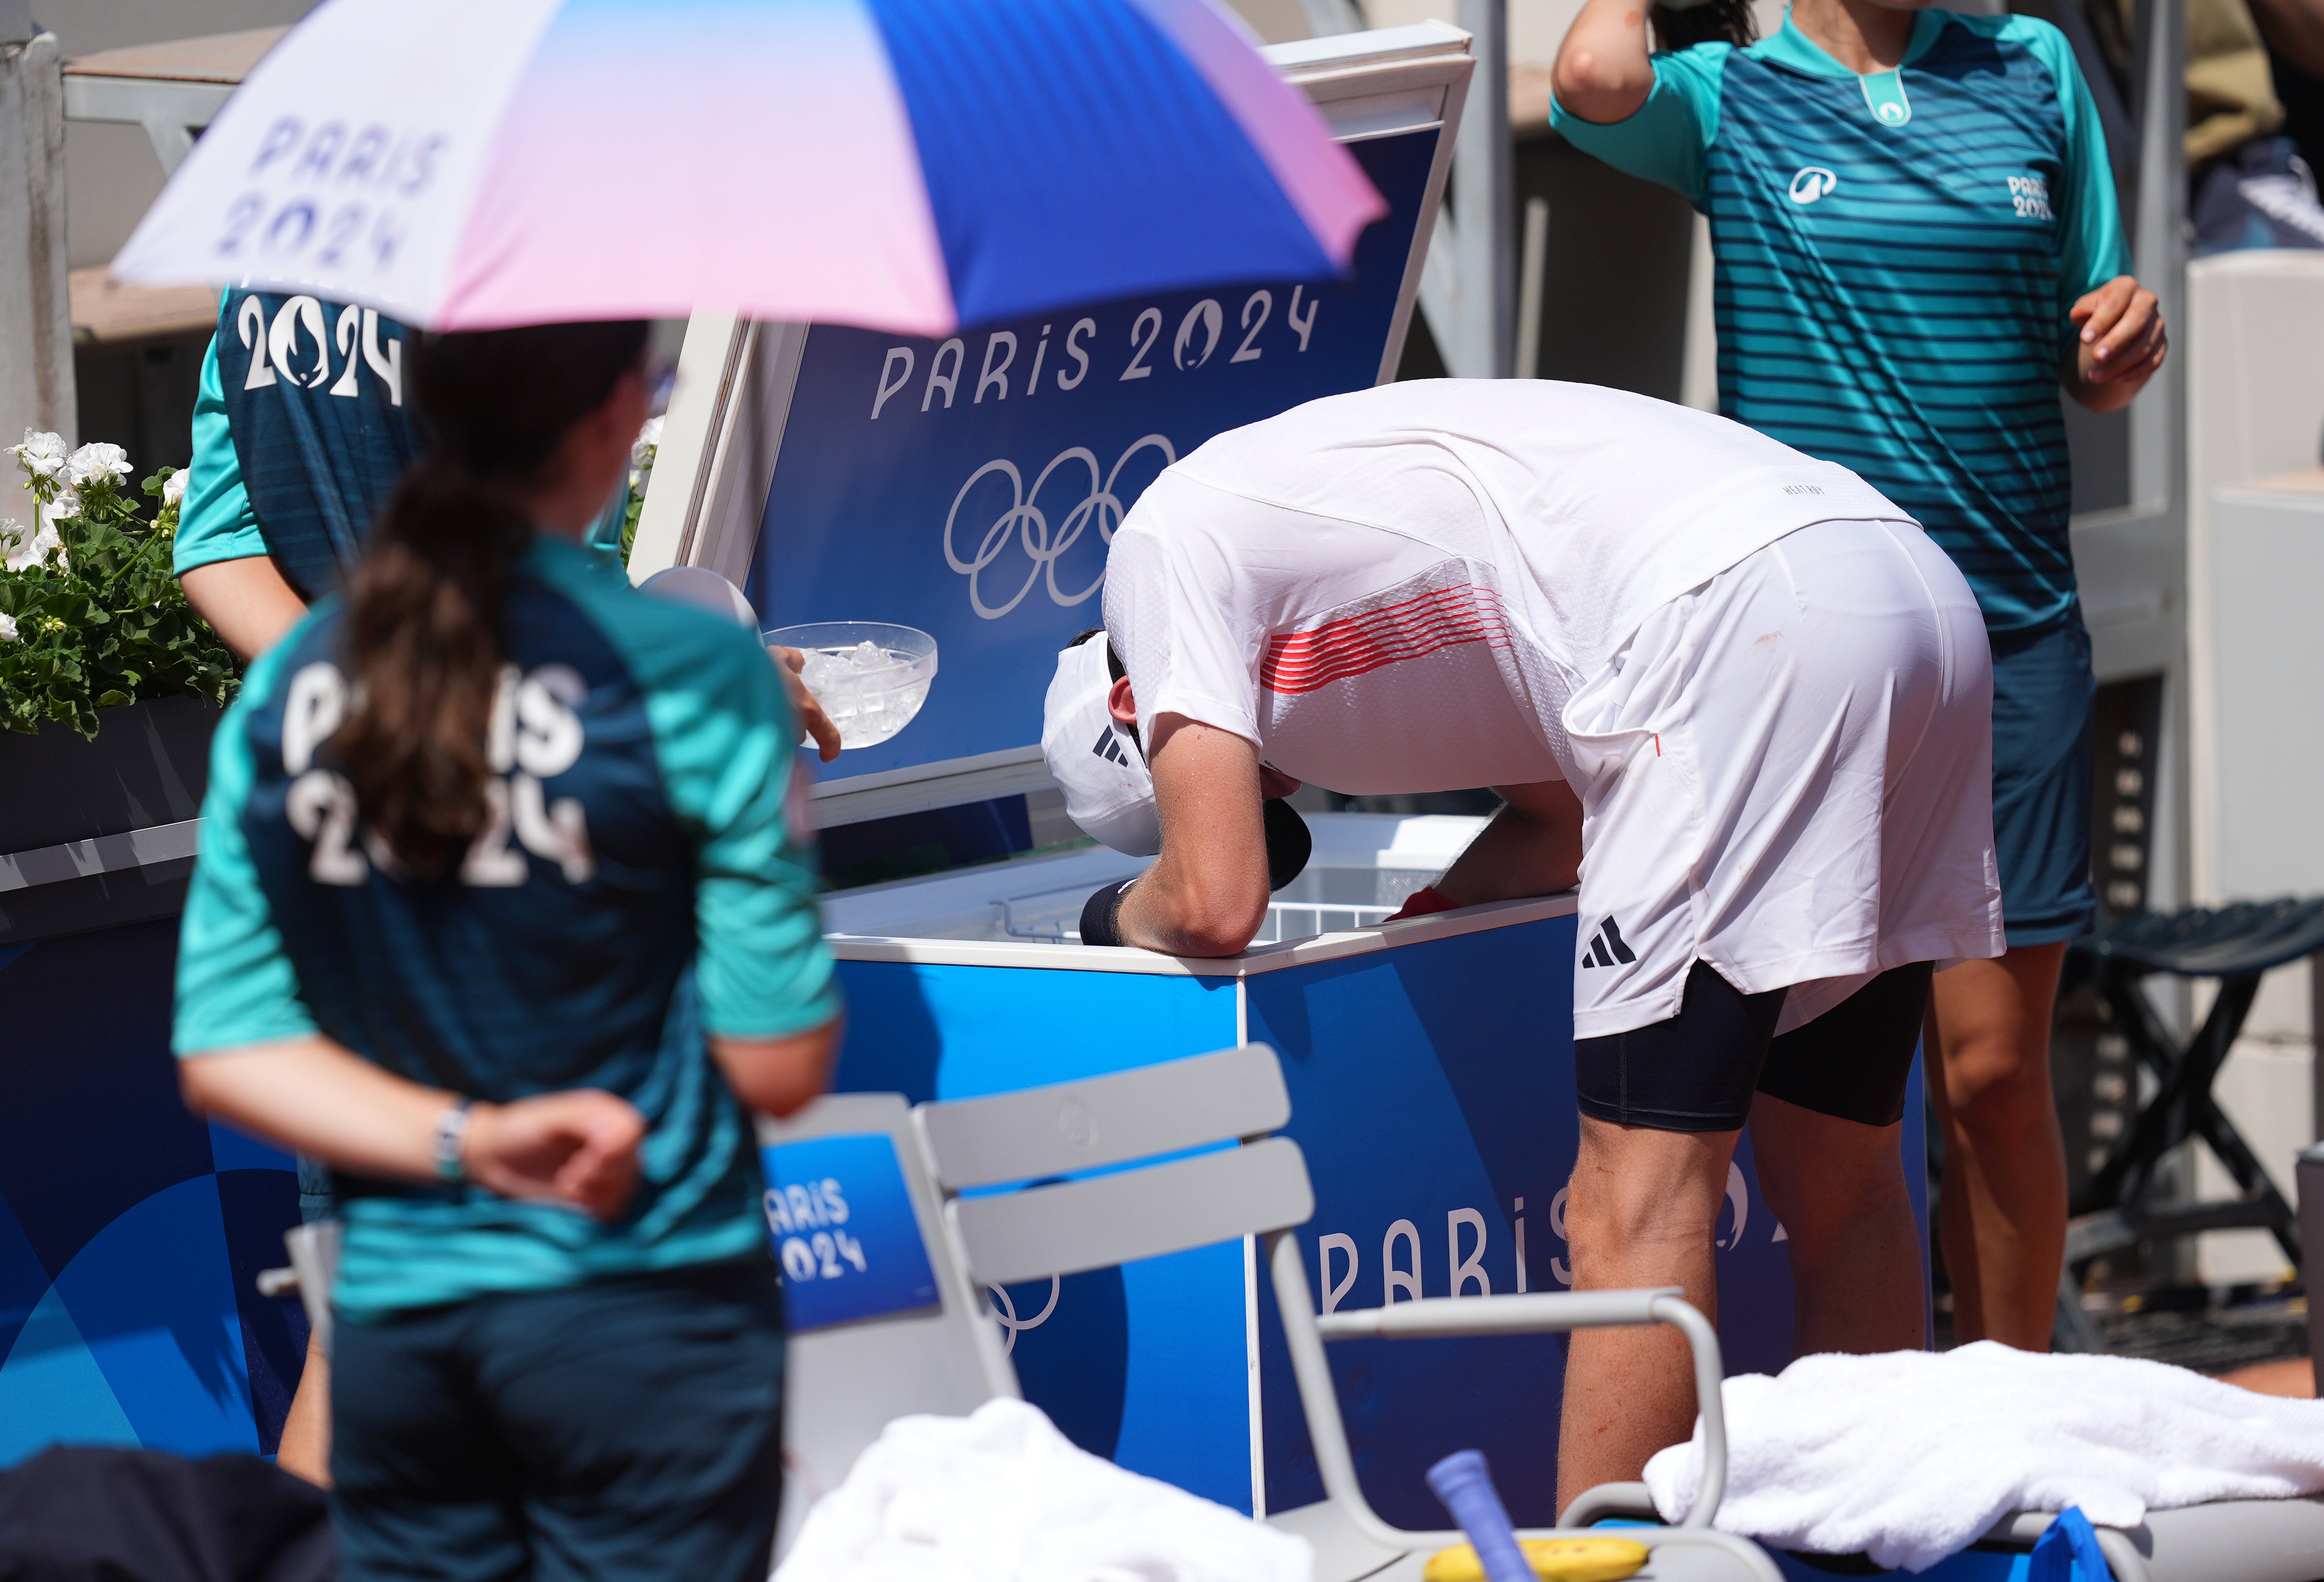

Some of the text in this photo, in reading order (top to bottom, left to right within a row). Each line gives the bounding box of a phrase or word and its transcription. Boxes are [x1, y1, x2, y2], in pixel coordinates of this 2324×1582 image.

[216, 190, 407, 270] 2024
[238, 294, 402, 406] 2024
[1119, 285, 1319, 381] 2024
[1782, 485, 1825, 495] HEAT.RDY
[282, 661, 587, 778] PIS
[285, 768, 594, 887] 224
[762, 1177, 850, 1236] ARIS
[781, 1229, 868, 1283] 024
